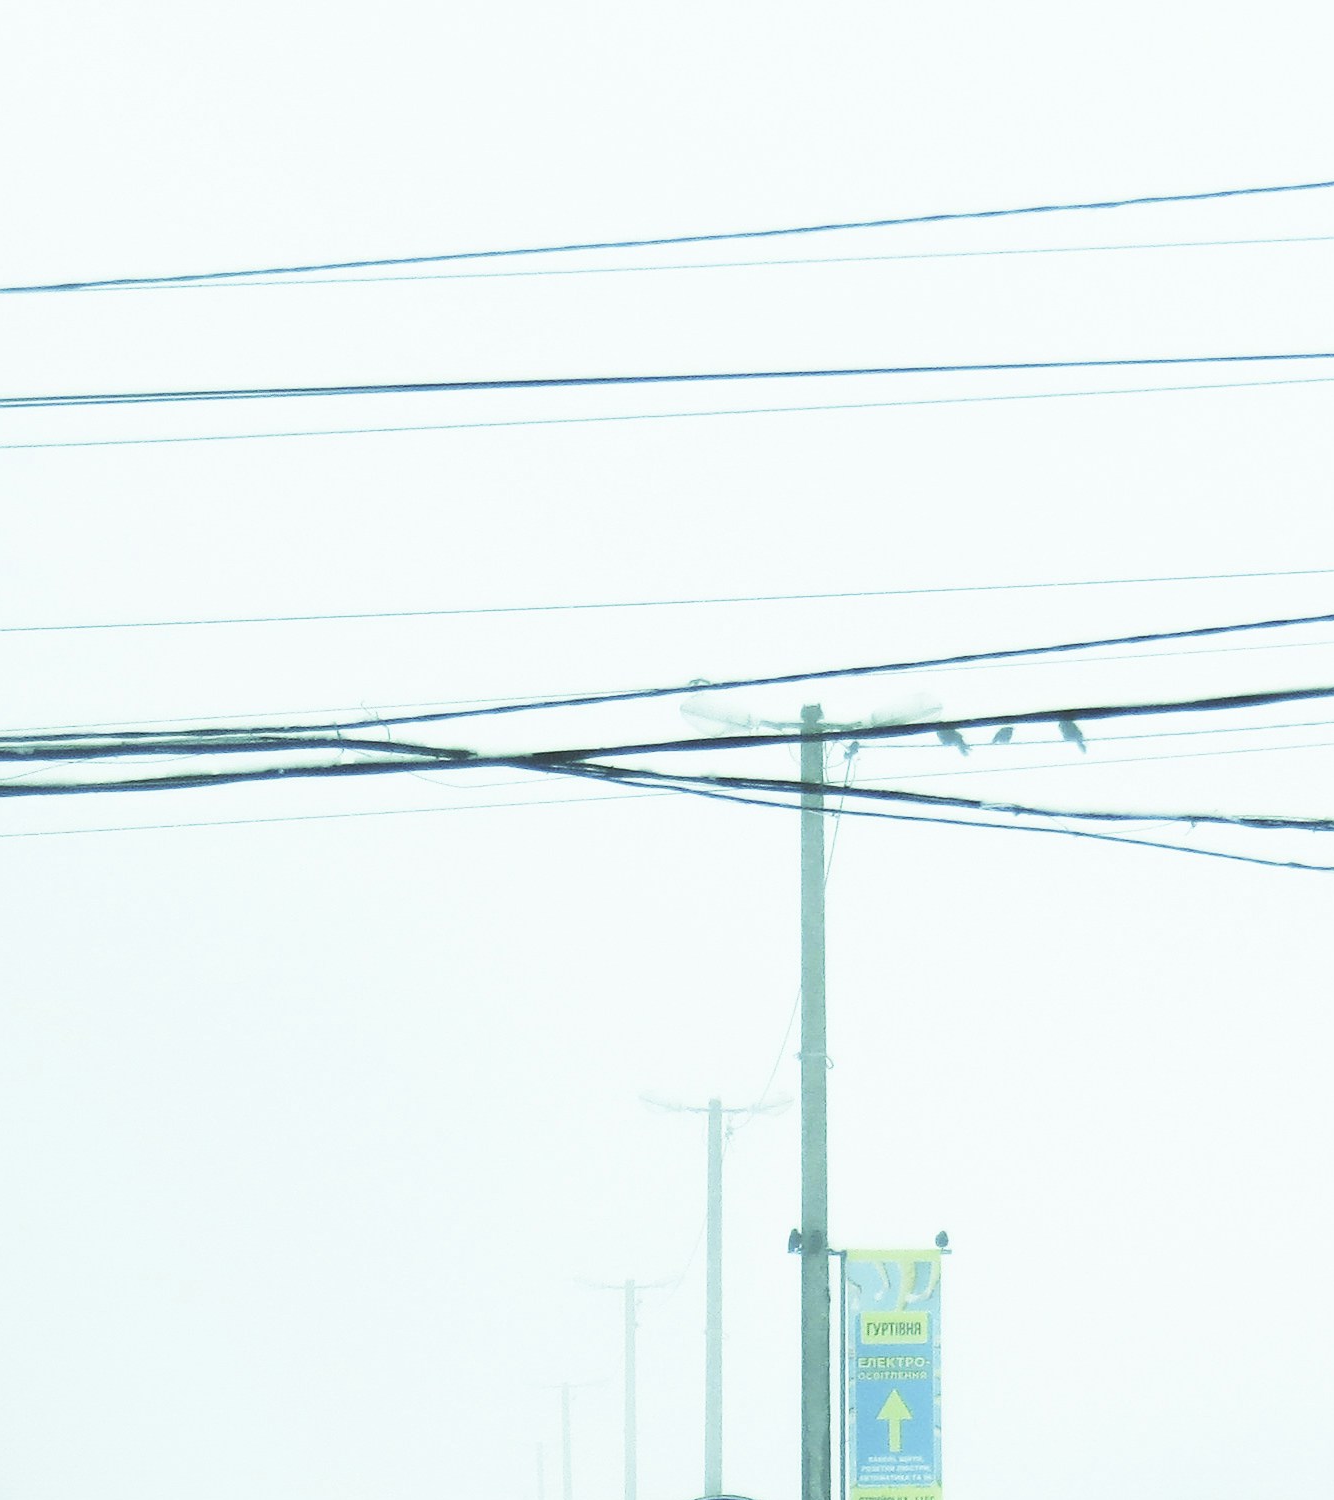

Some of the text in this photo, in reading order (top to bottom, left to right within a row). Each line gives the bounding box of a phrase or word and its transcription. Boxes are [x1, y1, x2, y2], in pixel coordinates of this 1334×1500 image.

[866, 1322, 921, 1336] ГУРТІВНЯ
[858, 1357, 931, 1368] ЕЛЕКТРО-
[858, 1372, 928, 1380] ОСВІТЛЕННЯ
